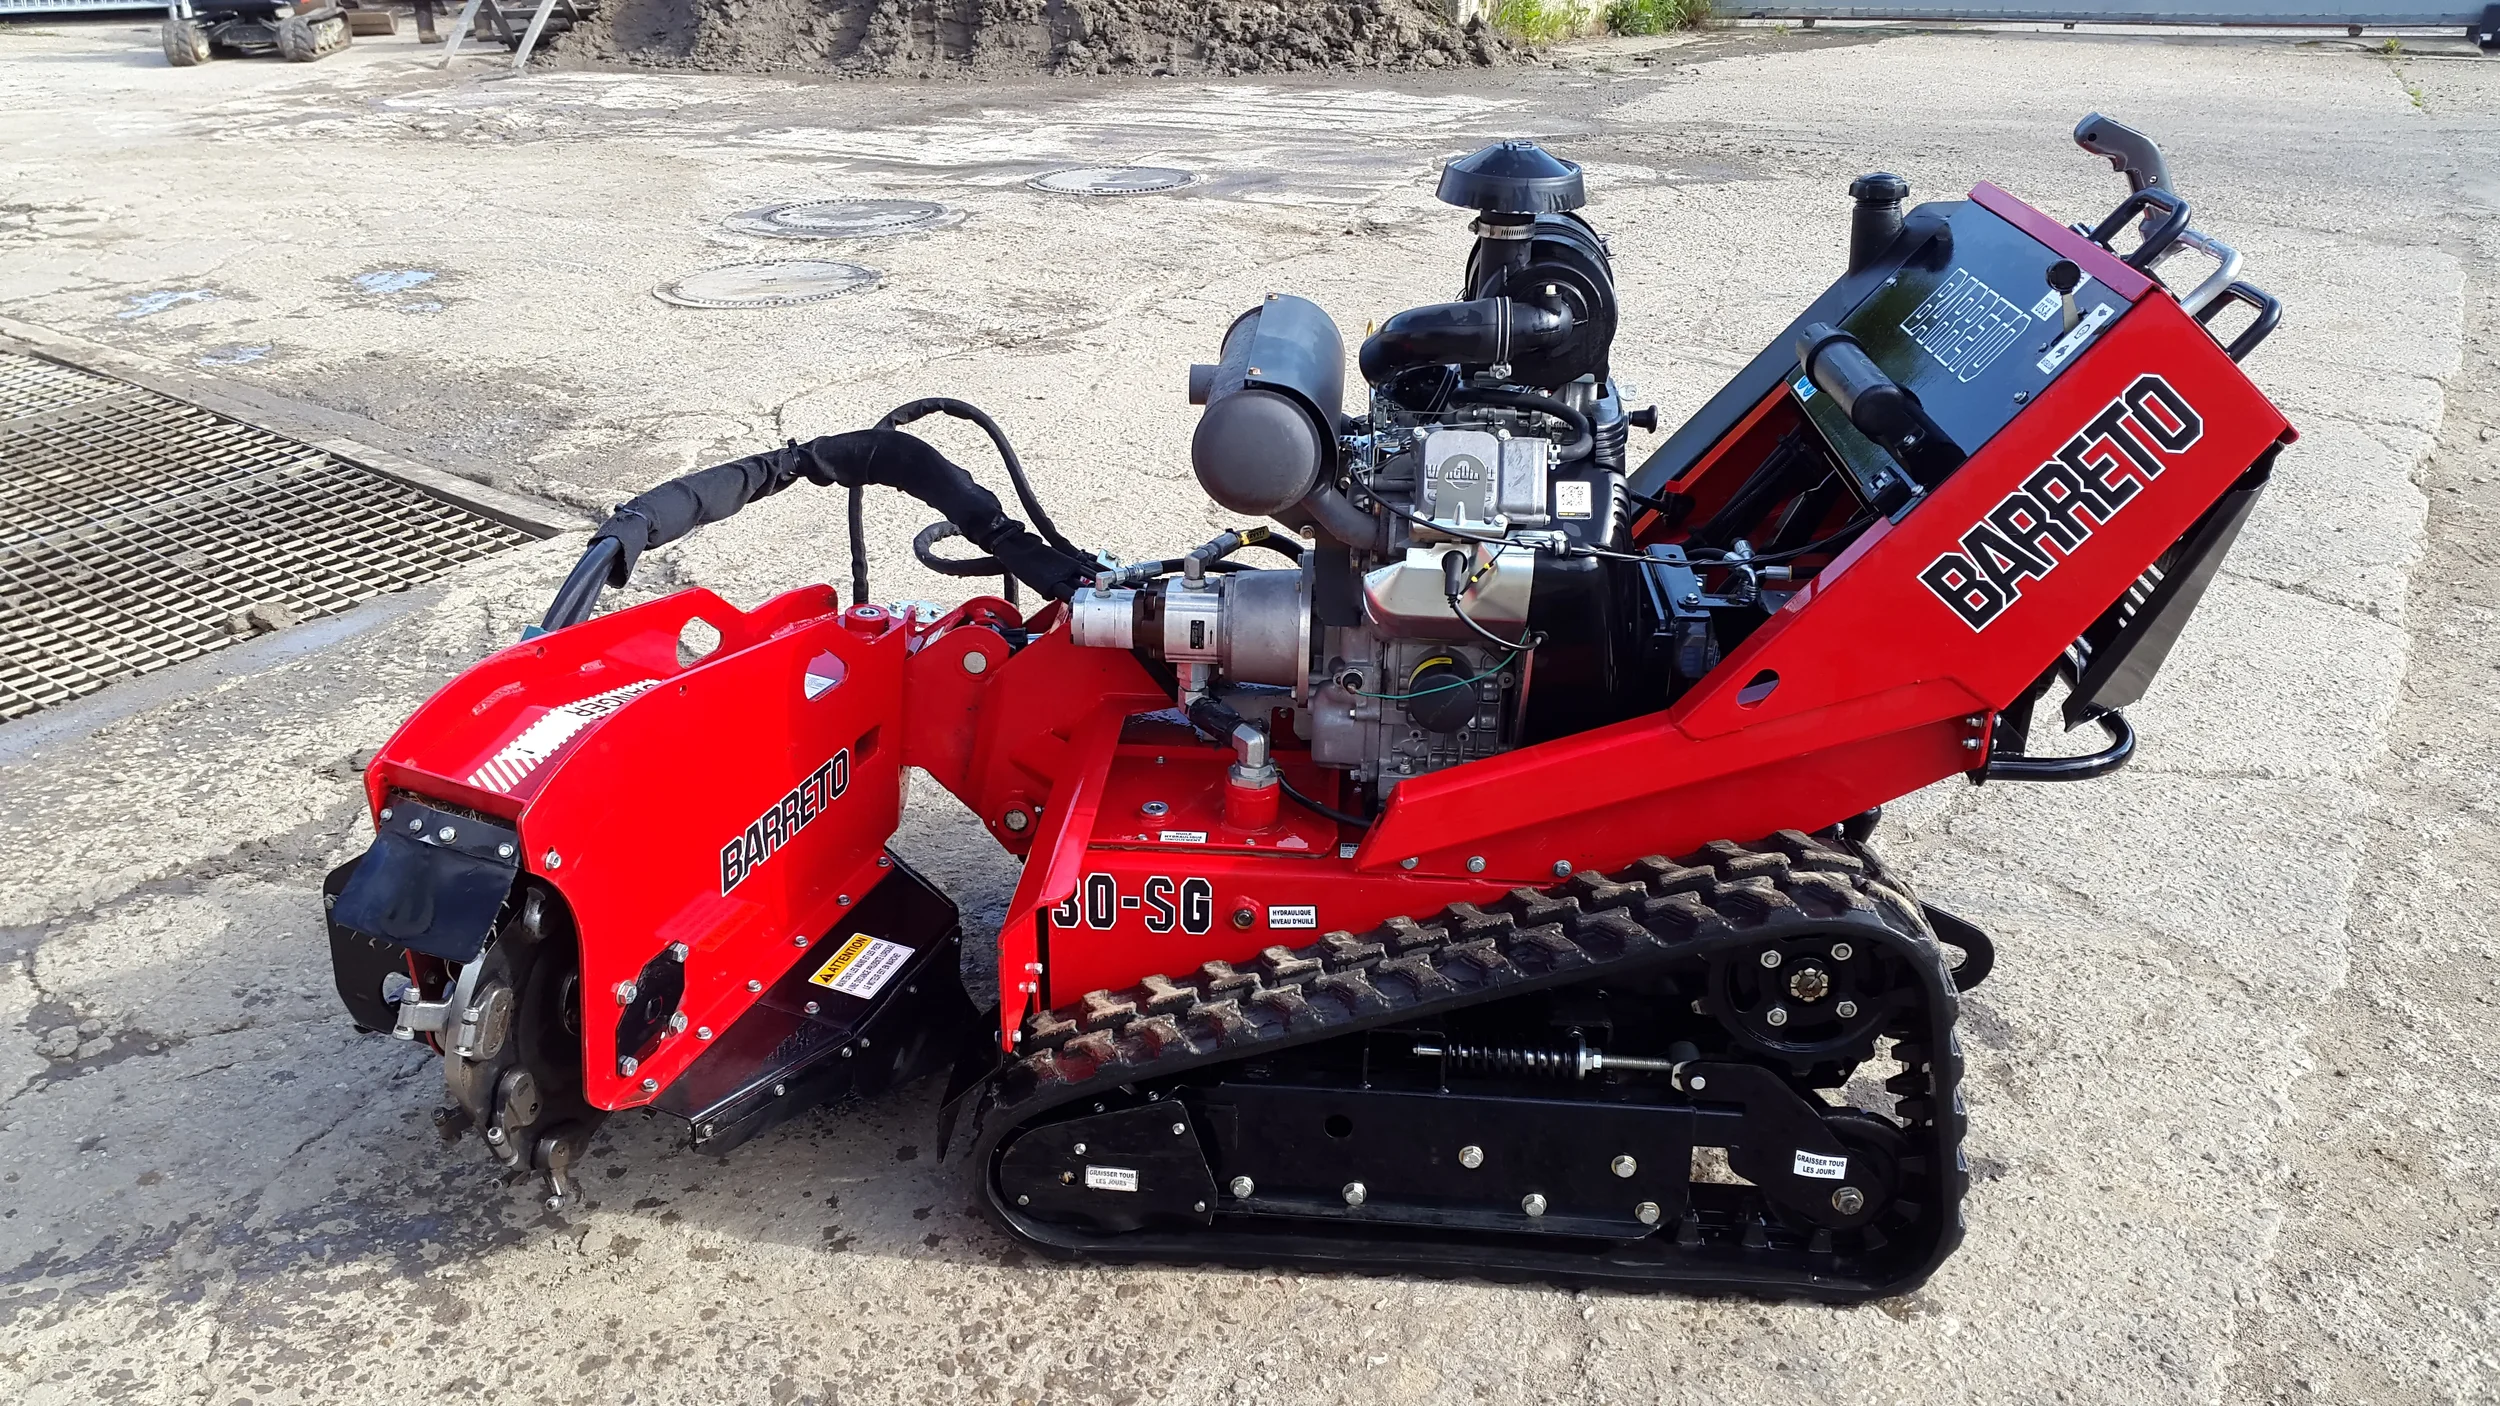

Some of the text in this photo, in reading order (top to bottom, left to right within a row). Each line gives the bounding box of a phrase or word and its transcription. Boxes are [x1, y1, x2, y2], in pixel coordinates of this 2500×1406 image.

[1900, 267, 2032, 383] BARRETO
[1917, 373, 2203, 633] BARRETO
[720, 747, 850, 898] BARRETO
[826, 937, 868, 973] ATTENTION
[1089, 1169, 1118, 1177] GRAISSER
[1797, 1154, 1827, 1166] GRAISSER
[1802, 1165, 1814, 1173] LES
